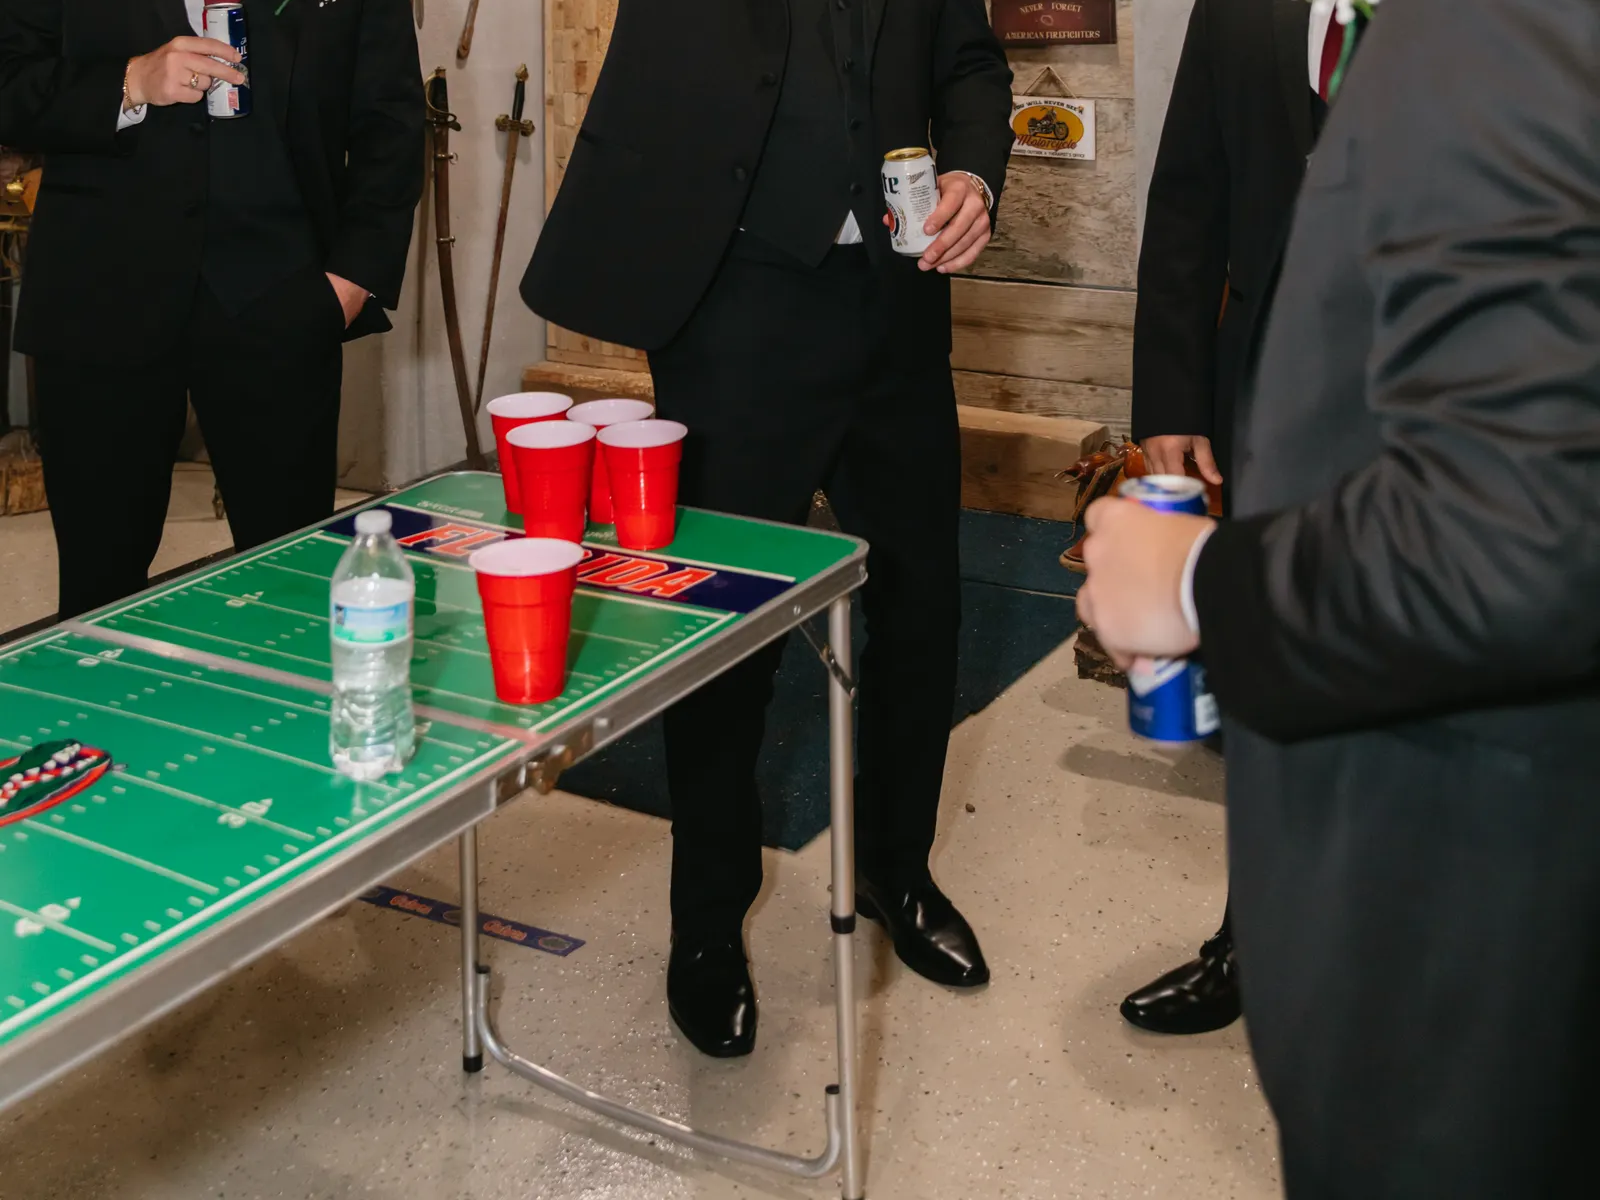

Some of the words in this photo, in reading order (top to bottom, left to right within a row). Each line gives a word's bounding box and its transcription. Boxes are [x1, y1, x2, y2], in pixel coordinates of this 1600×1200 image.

[1020, 3, 1044, 14] NEVER
[1051, 2, 1082, 13] FORGET
[1005, 32, 1045, 40] AMERICAN
[1045, 31, 1101, 39] FIREFIGHTERS
[1044, 100, 1065, 108] NEVER
[1017, 134, 1077, 152] Motorcycle
[395, 522, 718, 598] FLIDA
